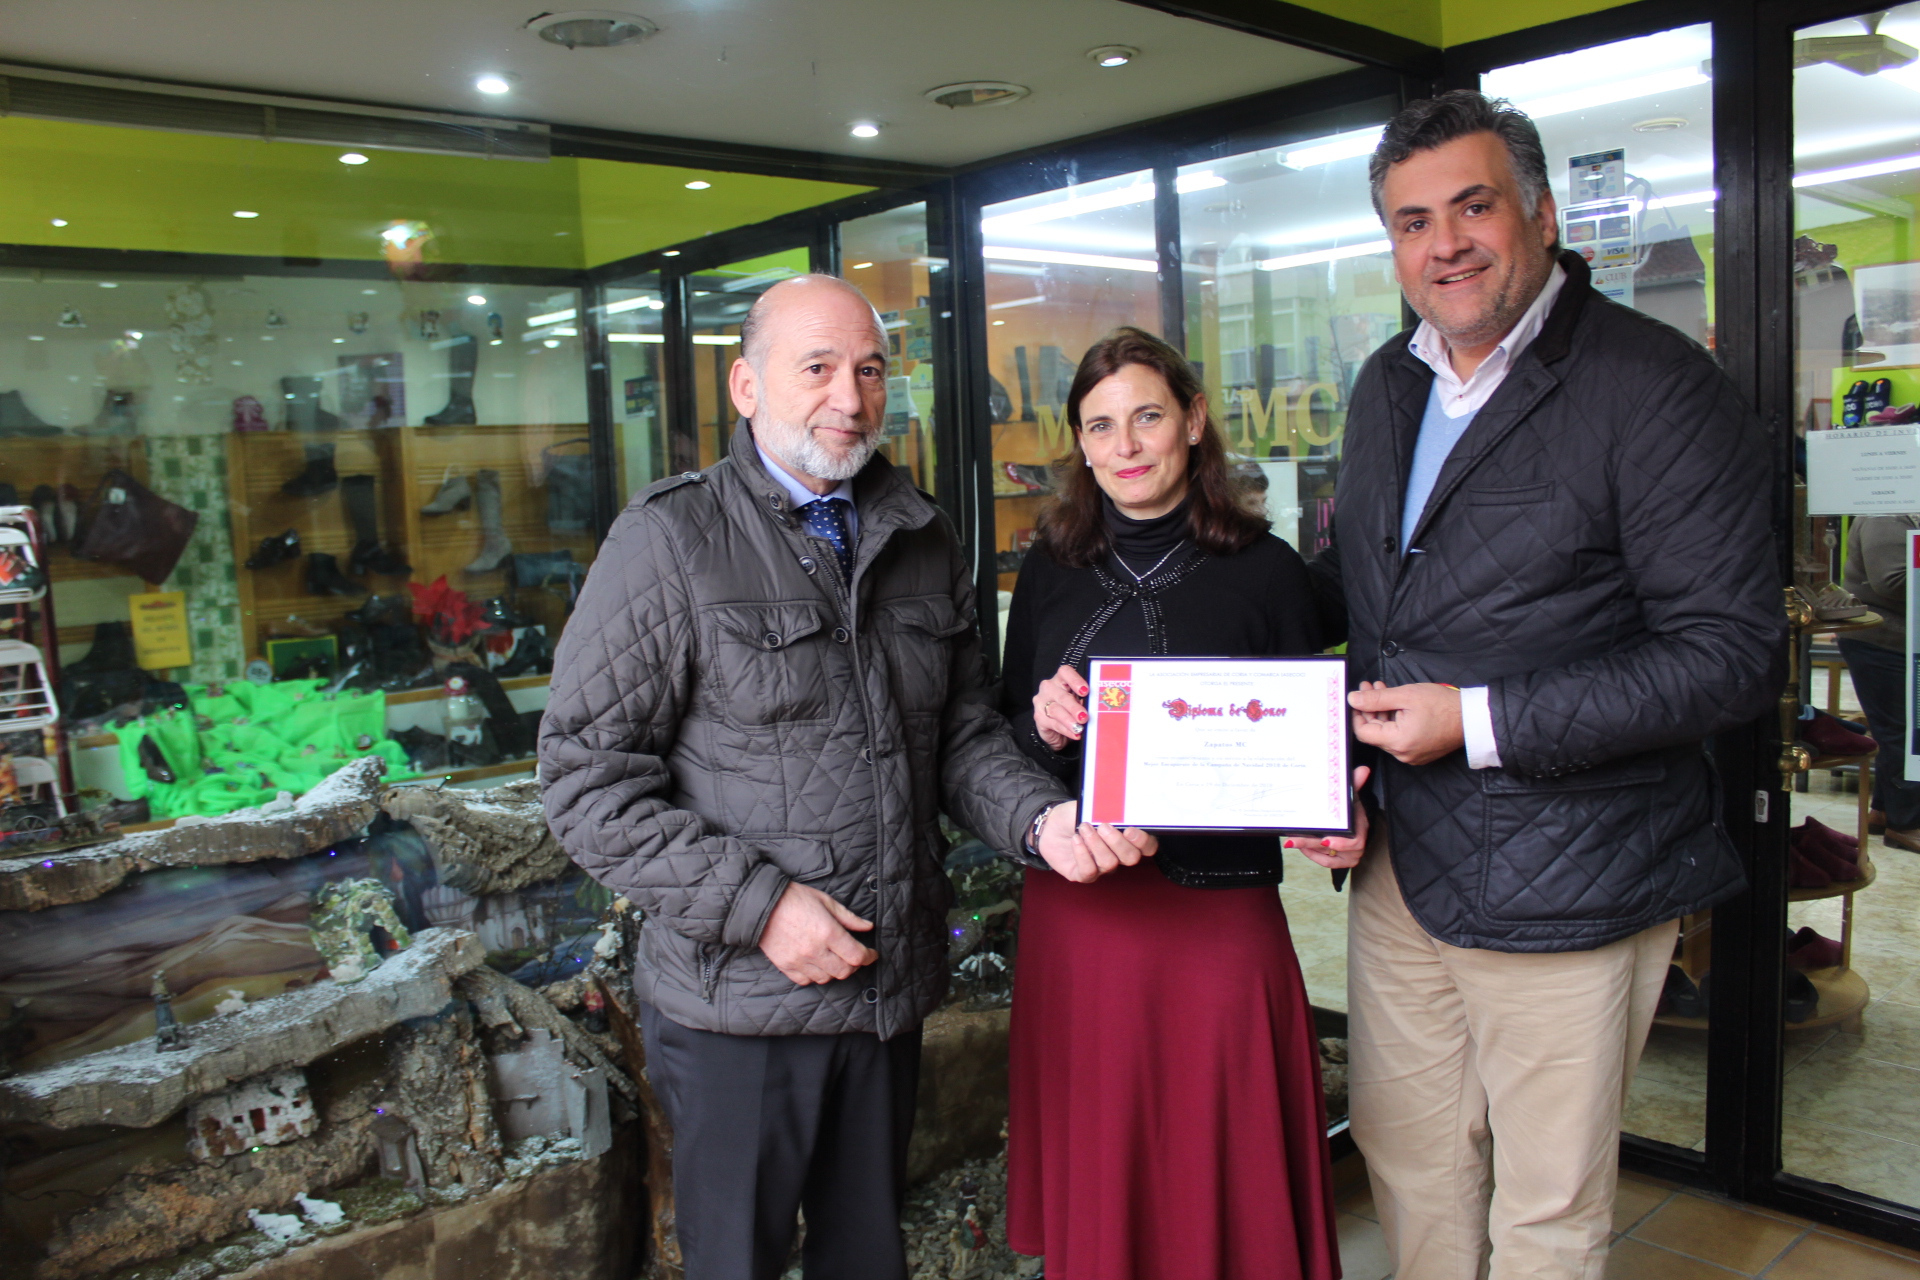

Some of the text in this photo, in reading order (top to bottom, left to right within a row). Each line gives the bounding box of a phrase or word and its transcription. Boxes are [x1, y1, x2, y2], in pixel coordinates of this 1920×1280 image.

[1607, 247, 1624, 255] VISA
[1237, 383, 1342, 447] MC
[1162, 697, 1223, 721] Diploma
[1204, 741, 1233, 749] Zapatos
